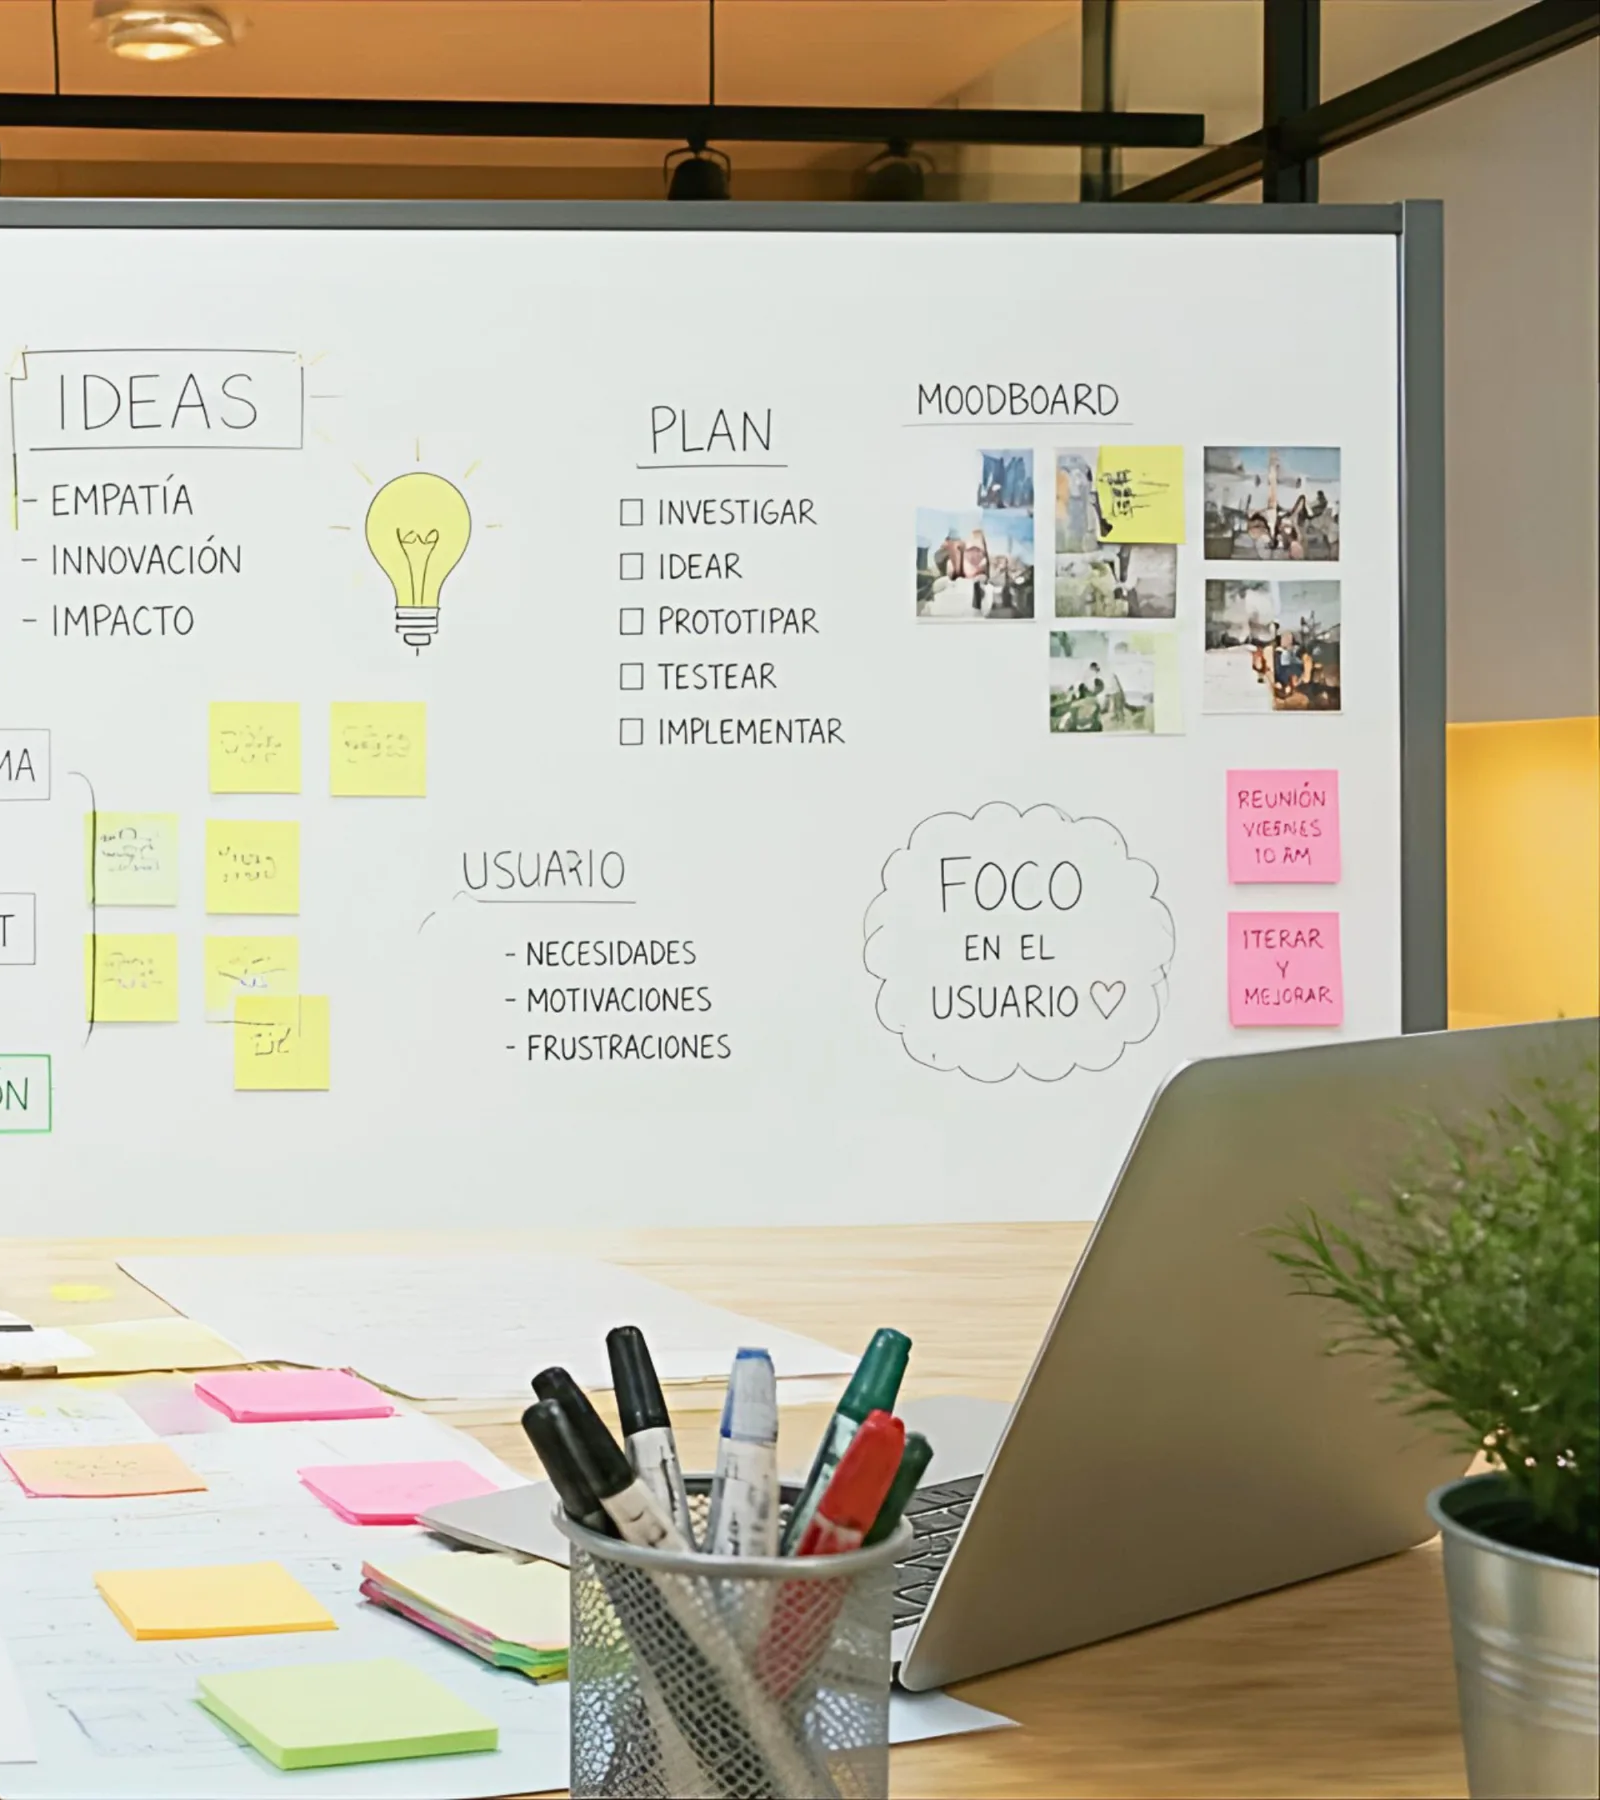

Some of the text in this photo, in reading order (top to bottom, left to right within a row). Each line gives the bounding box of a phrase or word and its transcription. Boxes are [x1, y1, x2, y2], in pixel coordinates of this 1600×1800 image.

[59, 372, 258, 431] IDEAS
[917, 381, 1120, 418] MOODBOARD
[650, 404, 773, 454] PLAN
[51, 472, 194, 518] EMPATÍA
[658, 497, 818, 527] INVESTIGAR
[51, 533, 242, 576] INNOVACIÓN
[659, 551, 744, 581] IDEAR
[52, 602, 195, 638] IMPACTO
[658, 605, 821, 637] PROTOTIPAR
[657, 661, 778, 691] TESTEAR
[658, 716, 847, 746] IMPLEMENTAR
[1237, 781, 1327, 810] REUNIÓN
[462, 848, 626, 891] USUARIO
[1255, 846, 1277, 865] 10
[939, 855, 1084, 913] FOCO
[526, 938, 698, 968] NECESIDADES
[964, 932, 1056, 963] EN EL
[1243, 928, 1324, 950] ITERAR
[1276, 960, 1290, 979] Y
[526, 985, 713, 1014] MOTIVACIONES
[931, 983, 1080, 1021] USUARIO
[1244, 985, 1334, 1007] MEJORAR
[527, 1032, 732, 1062] FRUSTRACIONES
